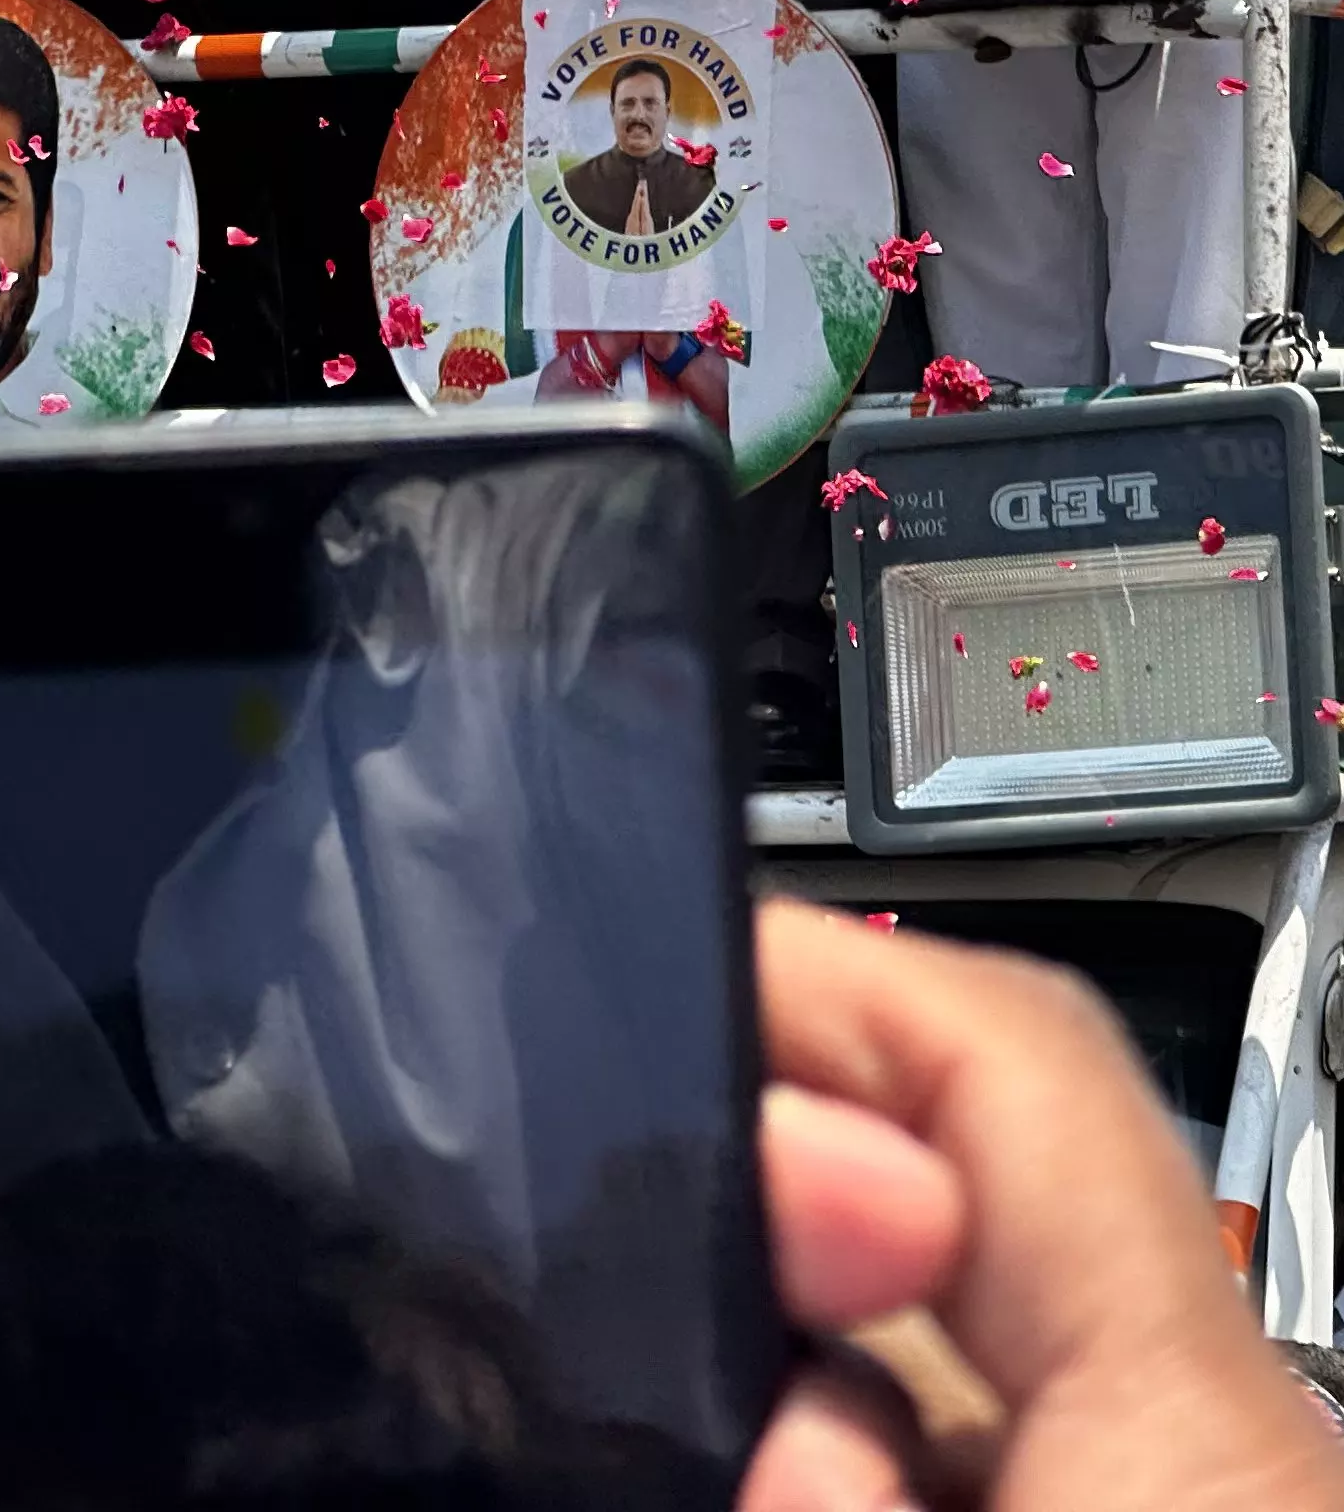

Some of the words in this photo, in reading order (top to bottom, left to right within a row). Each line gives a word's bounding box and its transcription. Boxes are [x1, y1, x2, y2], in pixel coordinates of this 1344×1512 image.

[542, 35, 608, 102] VOTE
[619, 24, 680, 50] FOR
[688, 41, 748, 120] HAND
[542, 185, 598, 252] VOTE
[605, 240, 660, 265] FOR
[668, 191, 735, 256] HAND
[893, 516, 947, 539] 300W
[989, 471, 1160, 531] LED
